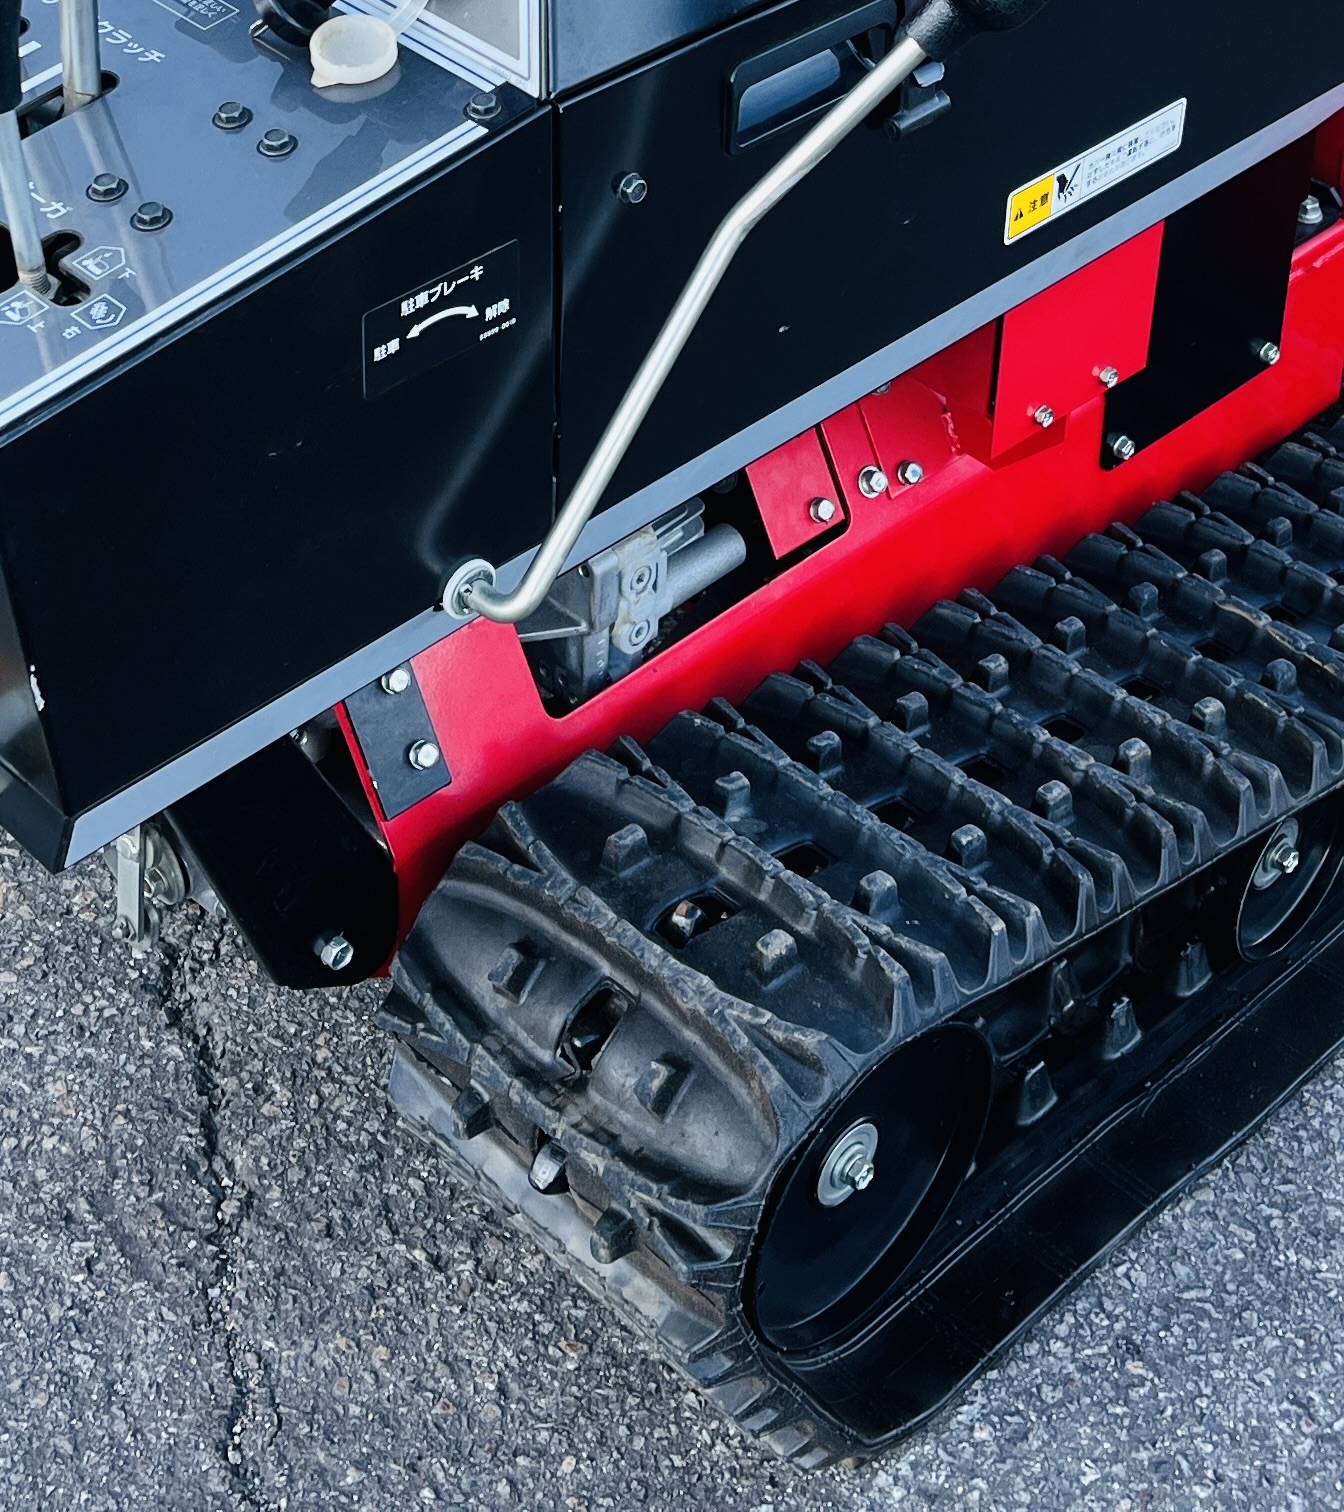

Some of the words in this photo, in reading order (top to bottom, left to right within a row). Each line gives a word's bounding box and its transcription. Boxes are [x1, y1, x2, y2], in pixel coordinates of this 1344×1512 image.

[28, 181, 74, 219] ーガ
[1028, 192, 1050, 214] 注意
[400, 265, 484, 317] 駐車ブレーキ
[373, 338, 400, 362] 駐車
